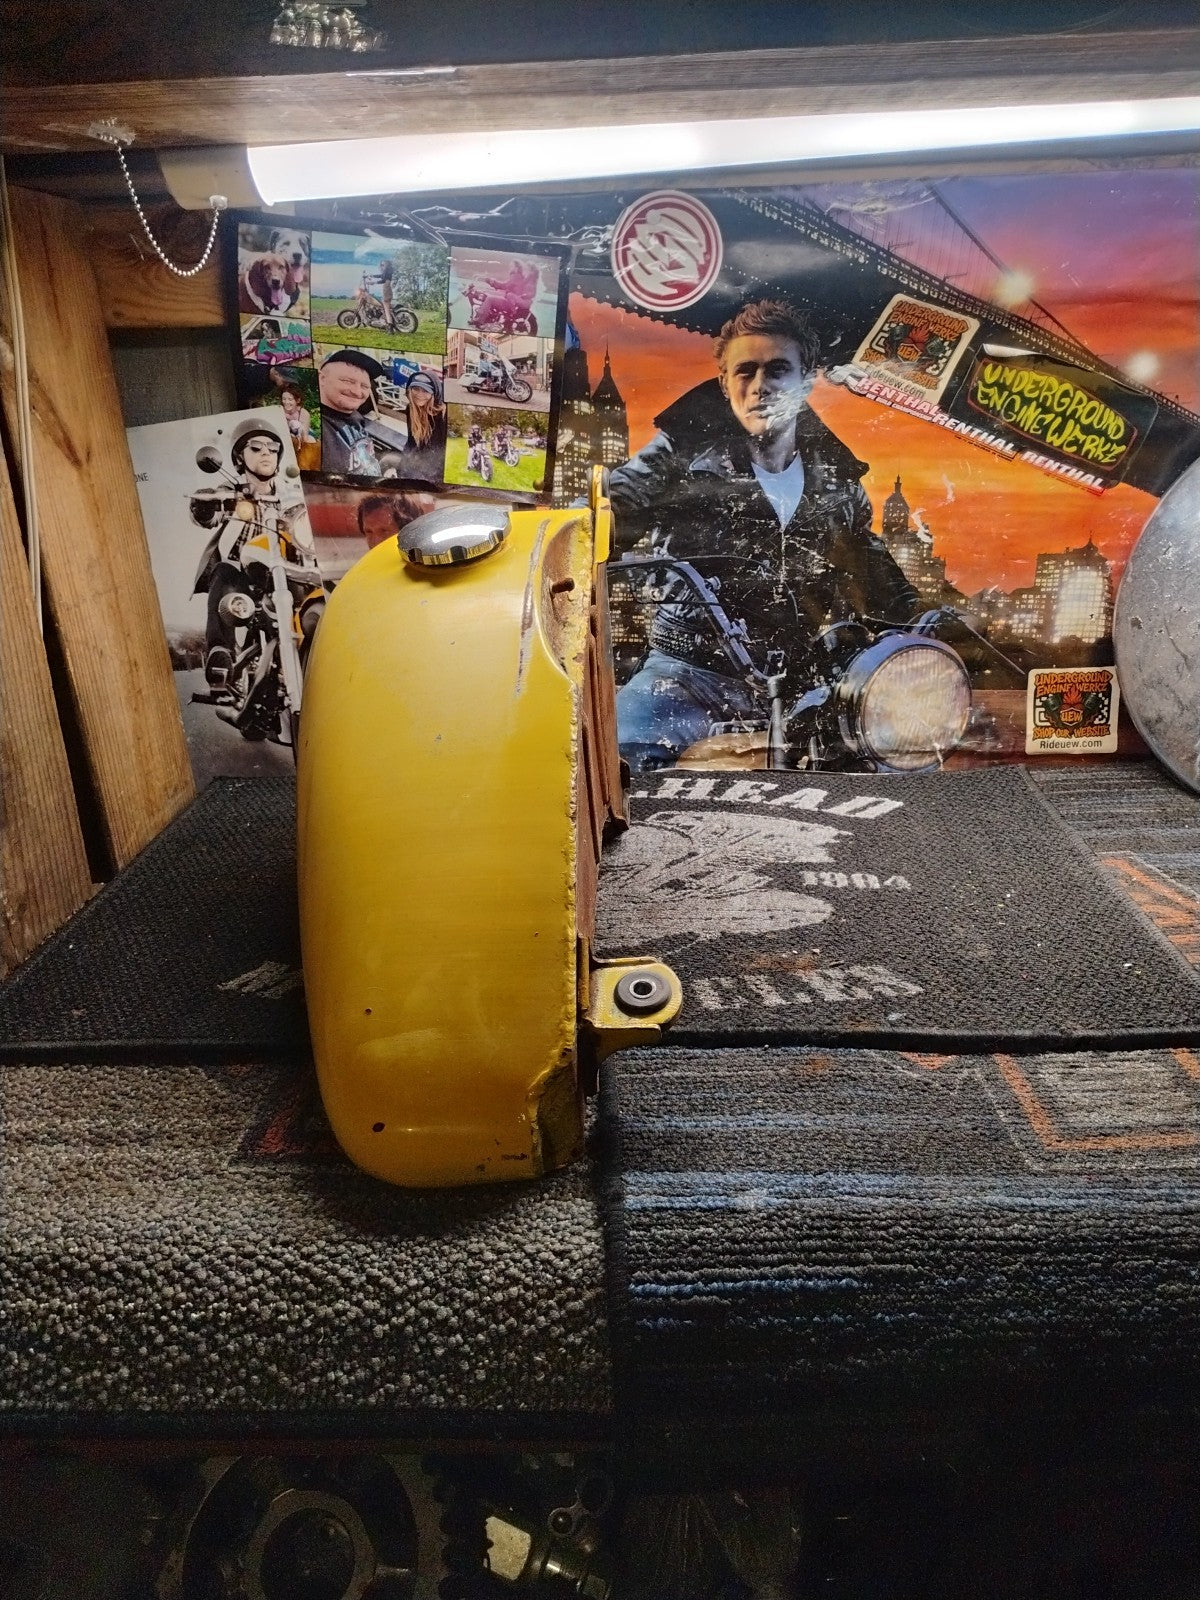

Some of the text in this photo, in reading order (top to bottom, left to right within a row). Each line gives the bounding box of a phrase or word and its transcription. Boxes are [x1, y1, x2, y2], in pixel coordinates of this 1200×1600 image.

[893, 300, 969, 334] UNDERGROUND
[928, 319, 960, 342] WERKZ
[857, 377, 941, 417] RENTHAL
[983, 362, 1125, 440] UNDERGROUND
[932, 412, 1016, 455] RENTHAL
[976, 380, 1055, 435] ENGINE
[1045, 416, 1127, 463] WERKZ
[1020, 450, 1105, 490] RENTHAL
[1034, 670, 1113, 686] UNDERGROUND
[1036, 682, 1108, 698] ENGINE WERKZ
[1033, 726, 1055, 740] SHOP
[1073, 724, 1111, 738] WEBSITE
[1060, 710, 1083, 722] UEW
[1039, 739, 1103, 750] Rideuew.com
[630, 777, 904, 819] HEAD
